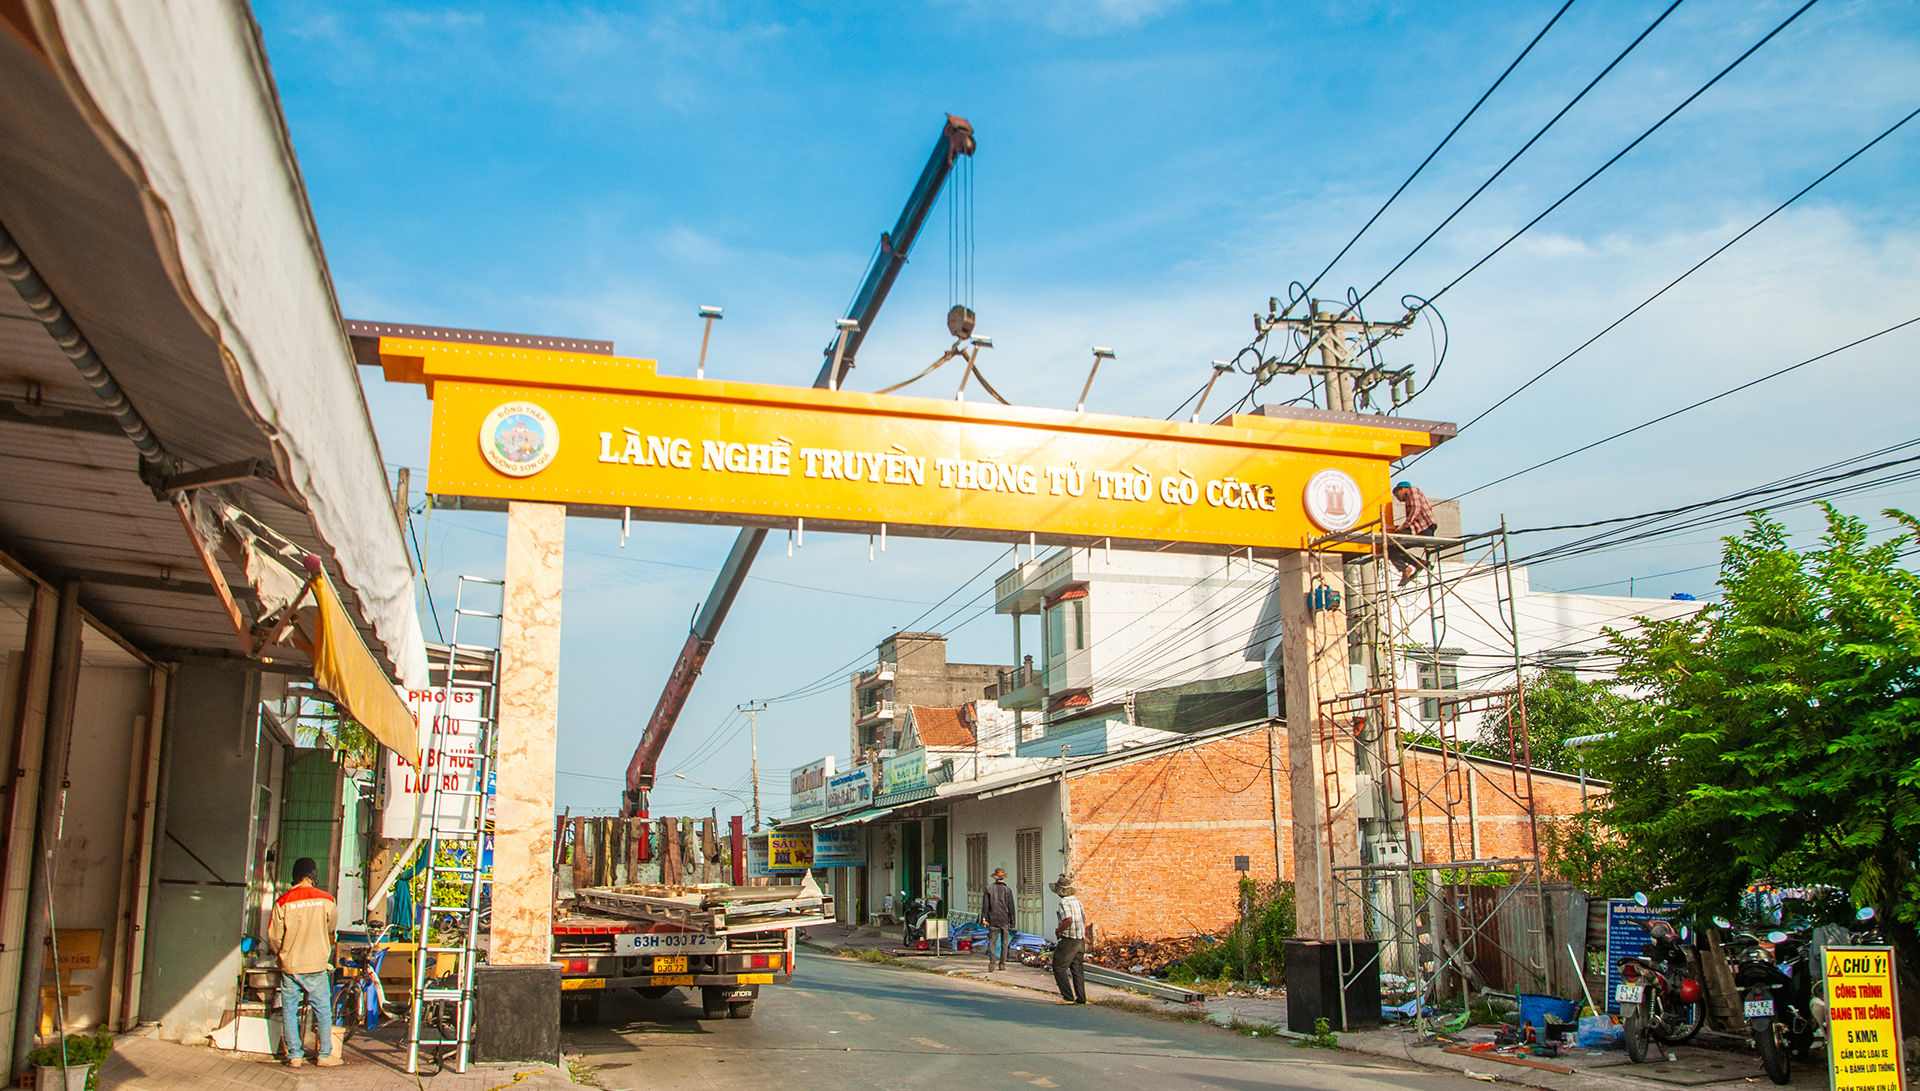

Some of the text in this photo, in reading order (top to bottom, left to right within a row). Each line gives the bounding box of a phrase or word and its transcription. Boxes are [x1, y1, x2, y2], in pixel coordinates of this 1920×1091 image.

[599, 426, 1276, 512] LÀNG NGHỀ TRUYỀN THỐNG TỦ THỜ GÒ CÔNG
[454, 692, 474, 703] 63
[657, 965, 684, 973] 030.72
[1843, 956, 1887, 974] CHÚ Ý!
[722, 988, 751, 998] HYUNDAI
[1835, 983, 1883, 999] CÔNG TRÌNH
[1831, 1004, 1891, 1020] ĐANG THI CÔNG
[1848, 1030, 1878, 1043] 5 KM/H
[1841, 1048, 1889, 1060] CẤM CÁC LOẠI XE
[1835, 1066, 1839, 1074] 3
[1850, 1063, 1865, 1073] BÁNH
[1878, 1062, 1895, 1072] THÔNG
